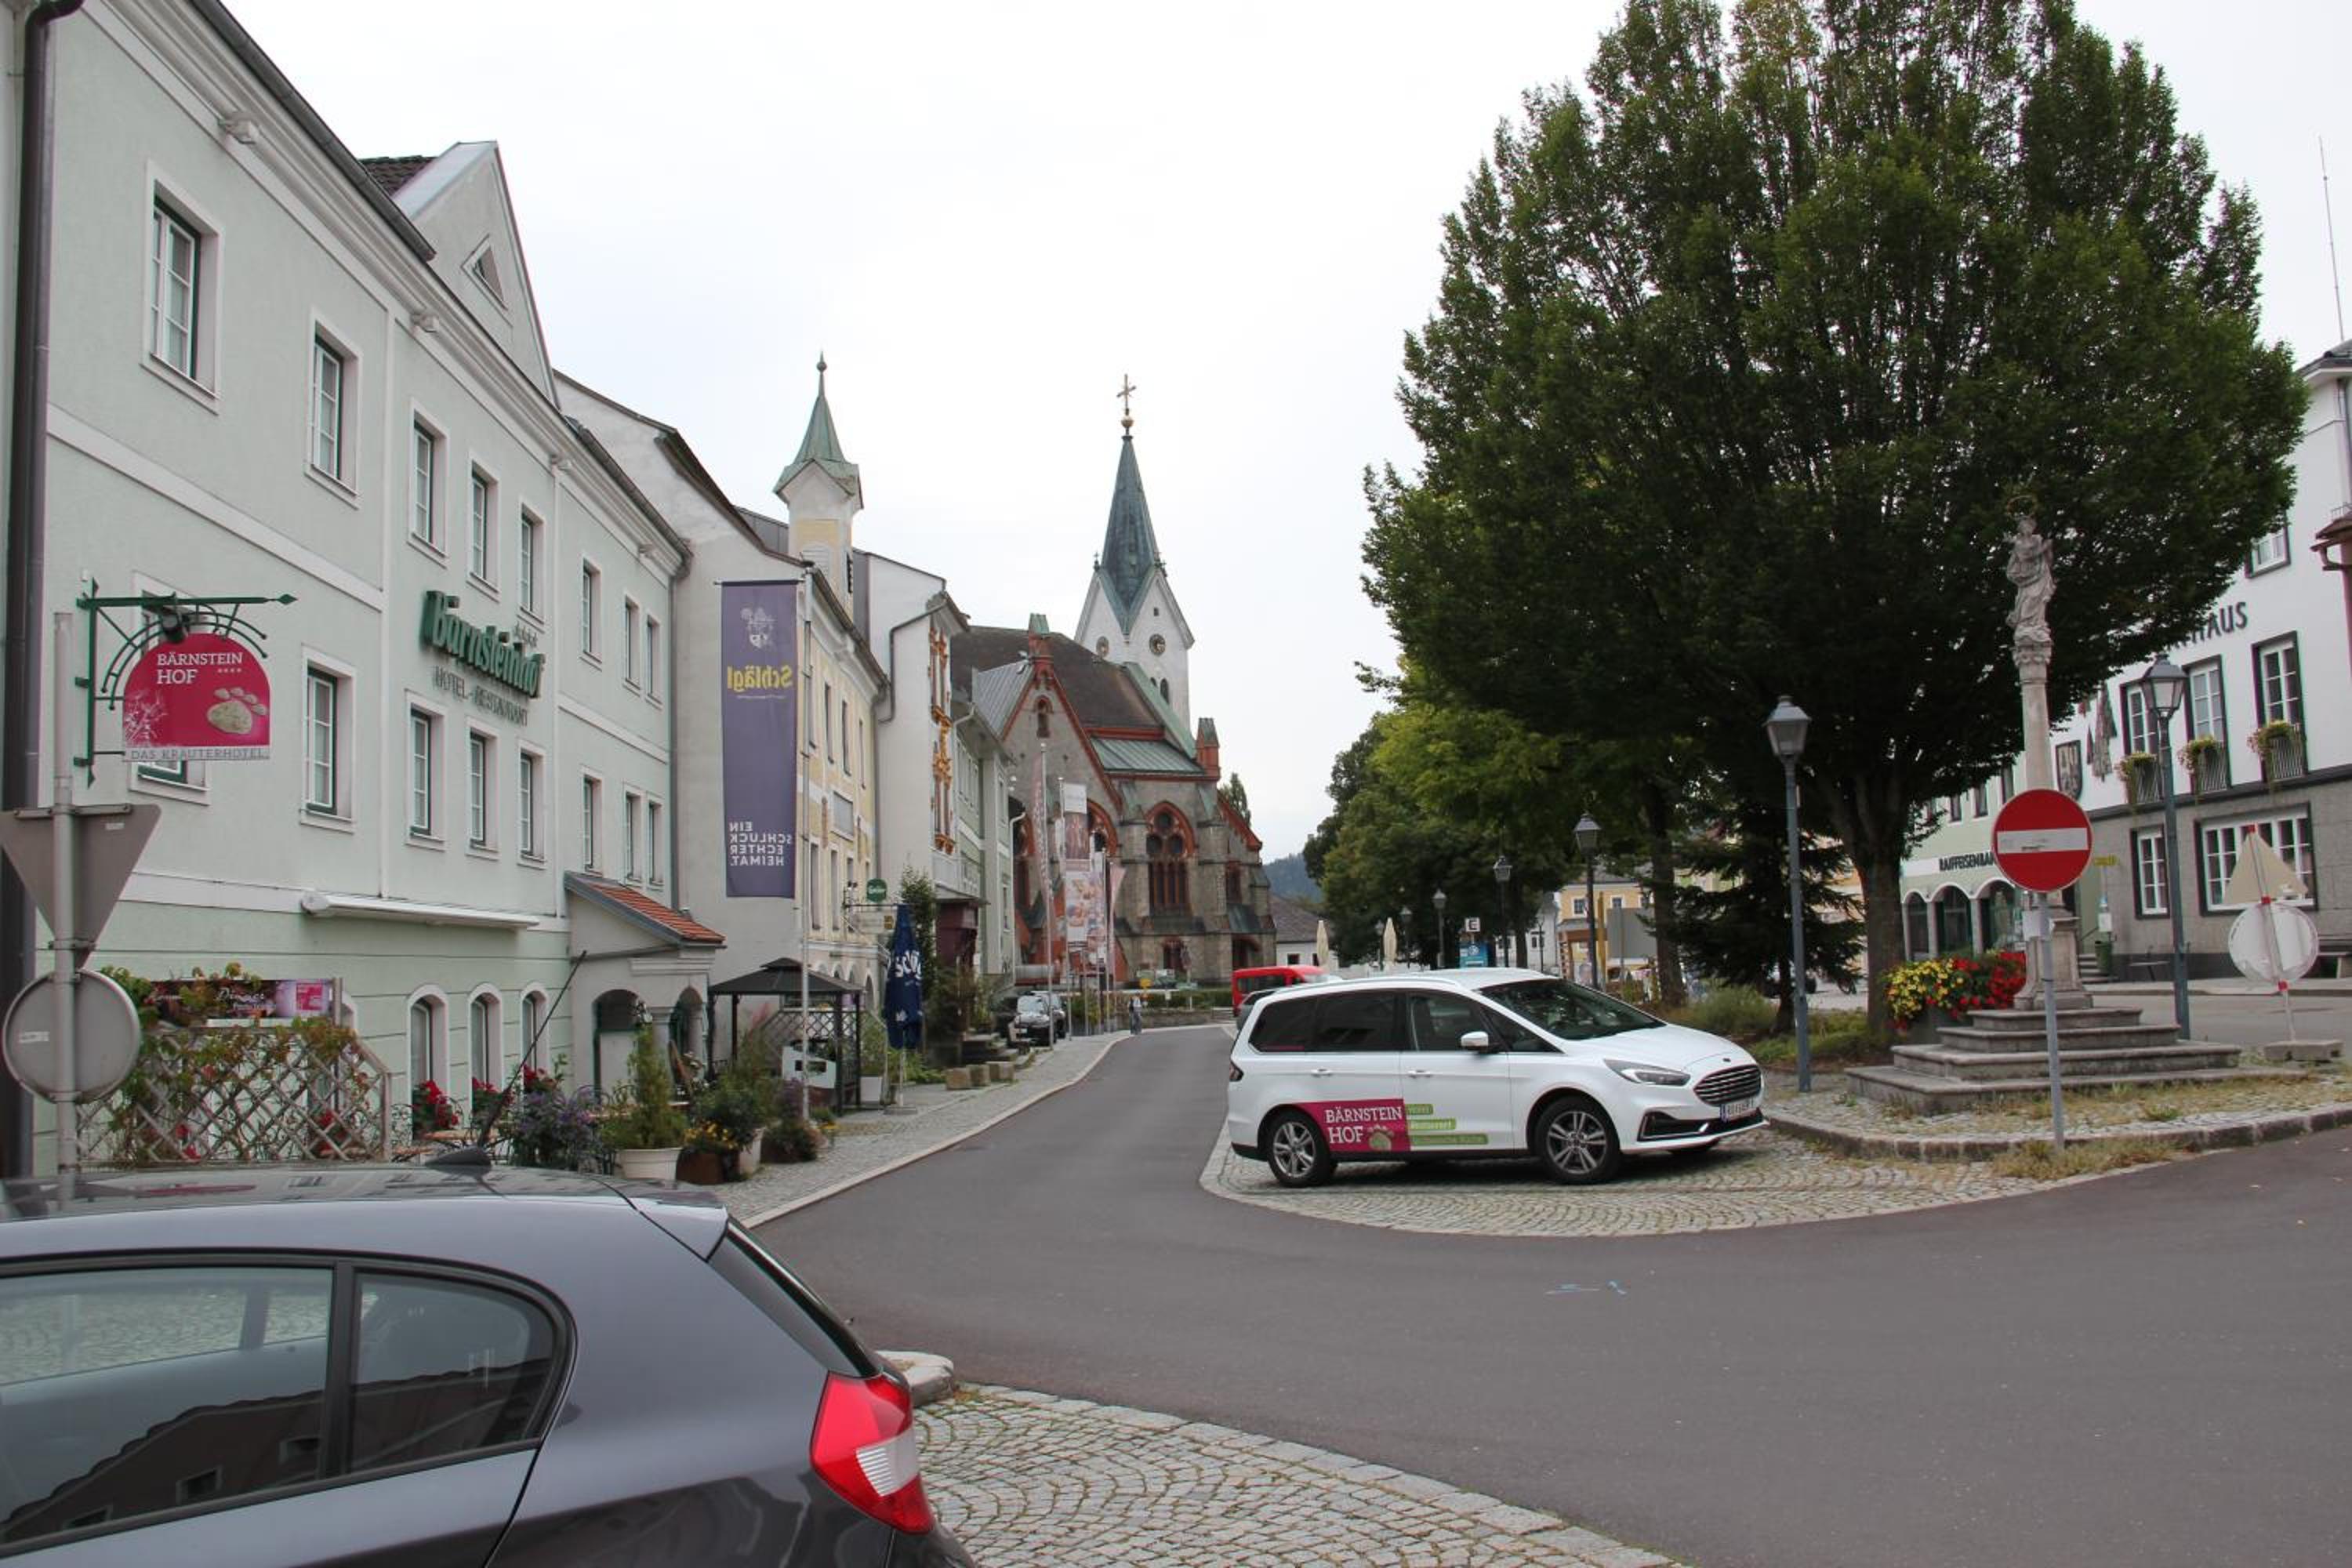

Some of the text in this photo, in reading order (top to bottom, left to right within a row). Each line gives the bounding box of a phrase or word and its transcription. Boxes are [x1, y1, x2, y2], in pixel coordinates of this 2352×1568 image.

[158, 652, 243, 666] BÄRNSTEIN
[157, 669, 198, 684] HOF
[434, 666, 468, 700] HOTEL
[131, 750, 155, 760] DAS
[1939, 851, 1995, 872] RAIFFEISENBAN
[1324, 1106, 1403, 1123] BÄRNSTEIN
[1328, 1125, 1364, 1144] HOF
